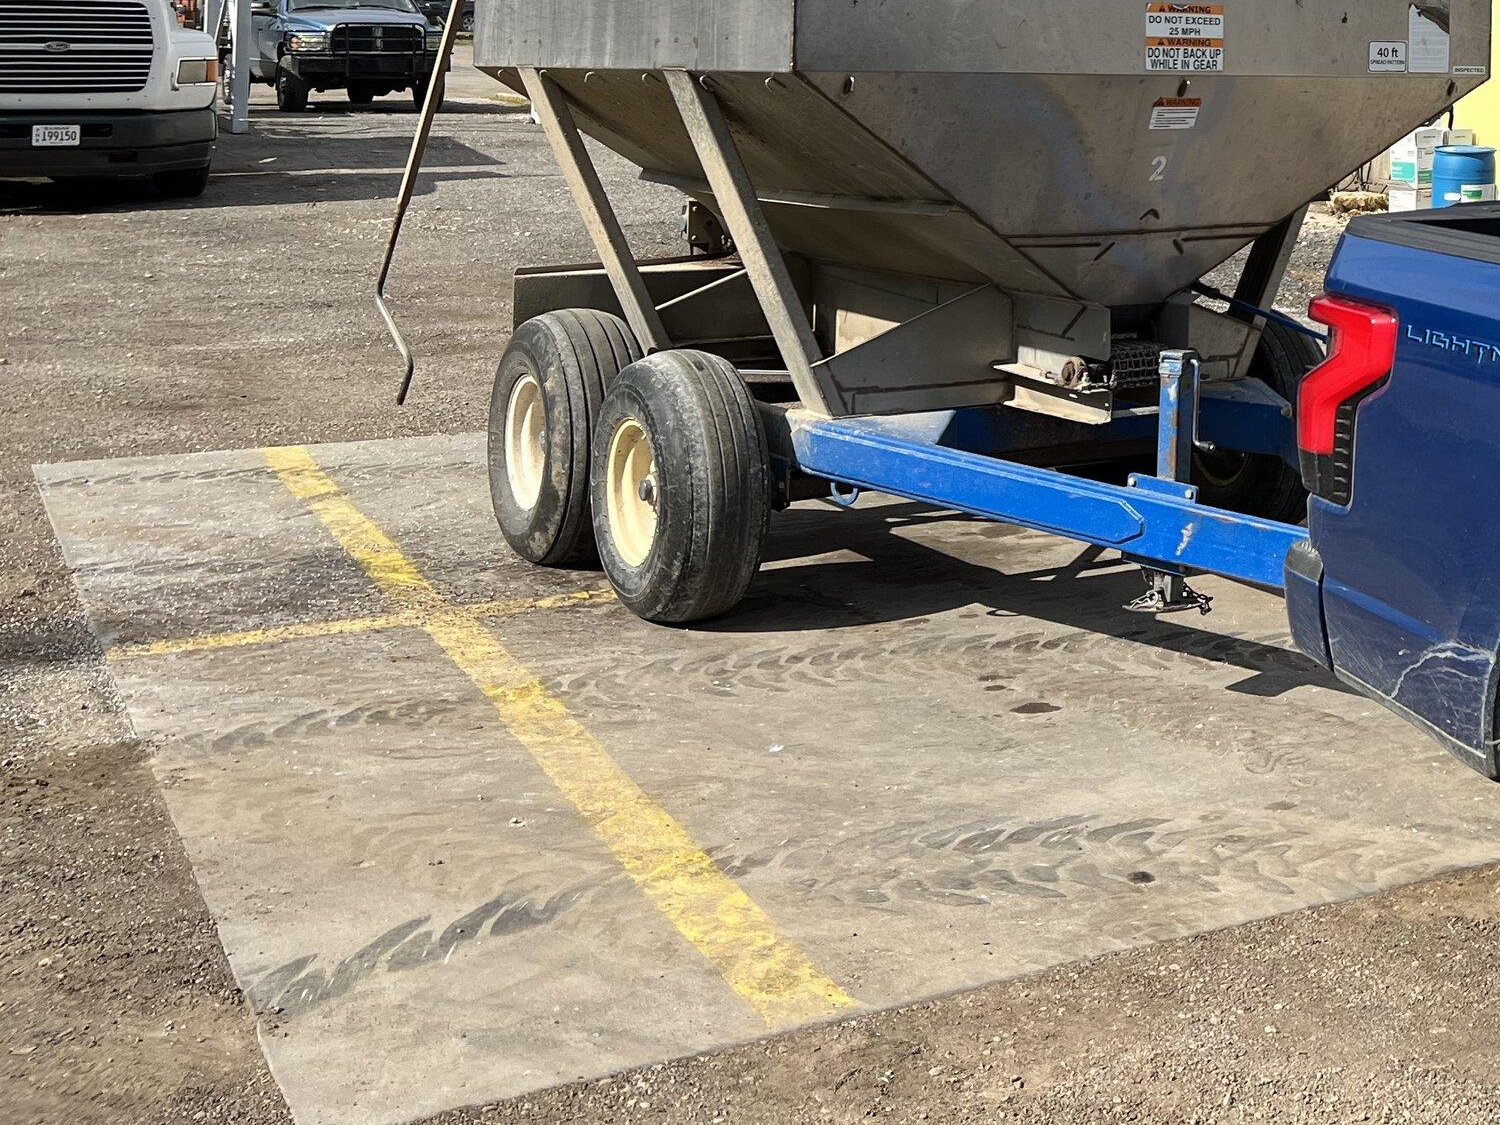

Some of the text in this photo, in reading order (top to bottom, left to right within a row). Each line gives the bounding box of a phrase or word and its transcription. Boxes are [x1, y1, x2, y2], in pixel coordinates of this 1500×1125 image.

[1148, 15, 1221, 25] DO NOT EXCEED
[1169, 27, 1201, 36] 25 MPH
[1167, 38, 1212, 47] WARNING
[1147, 47, 1221, 59] DO NOT BACK UP
[1377, 46, 1399, 58] 40 ft
[1150, 59, 1218, 70] WHILE IN GEAR
[41, 130, 77, 142] 199150
[1148, 155, 1167, 181] 2
